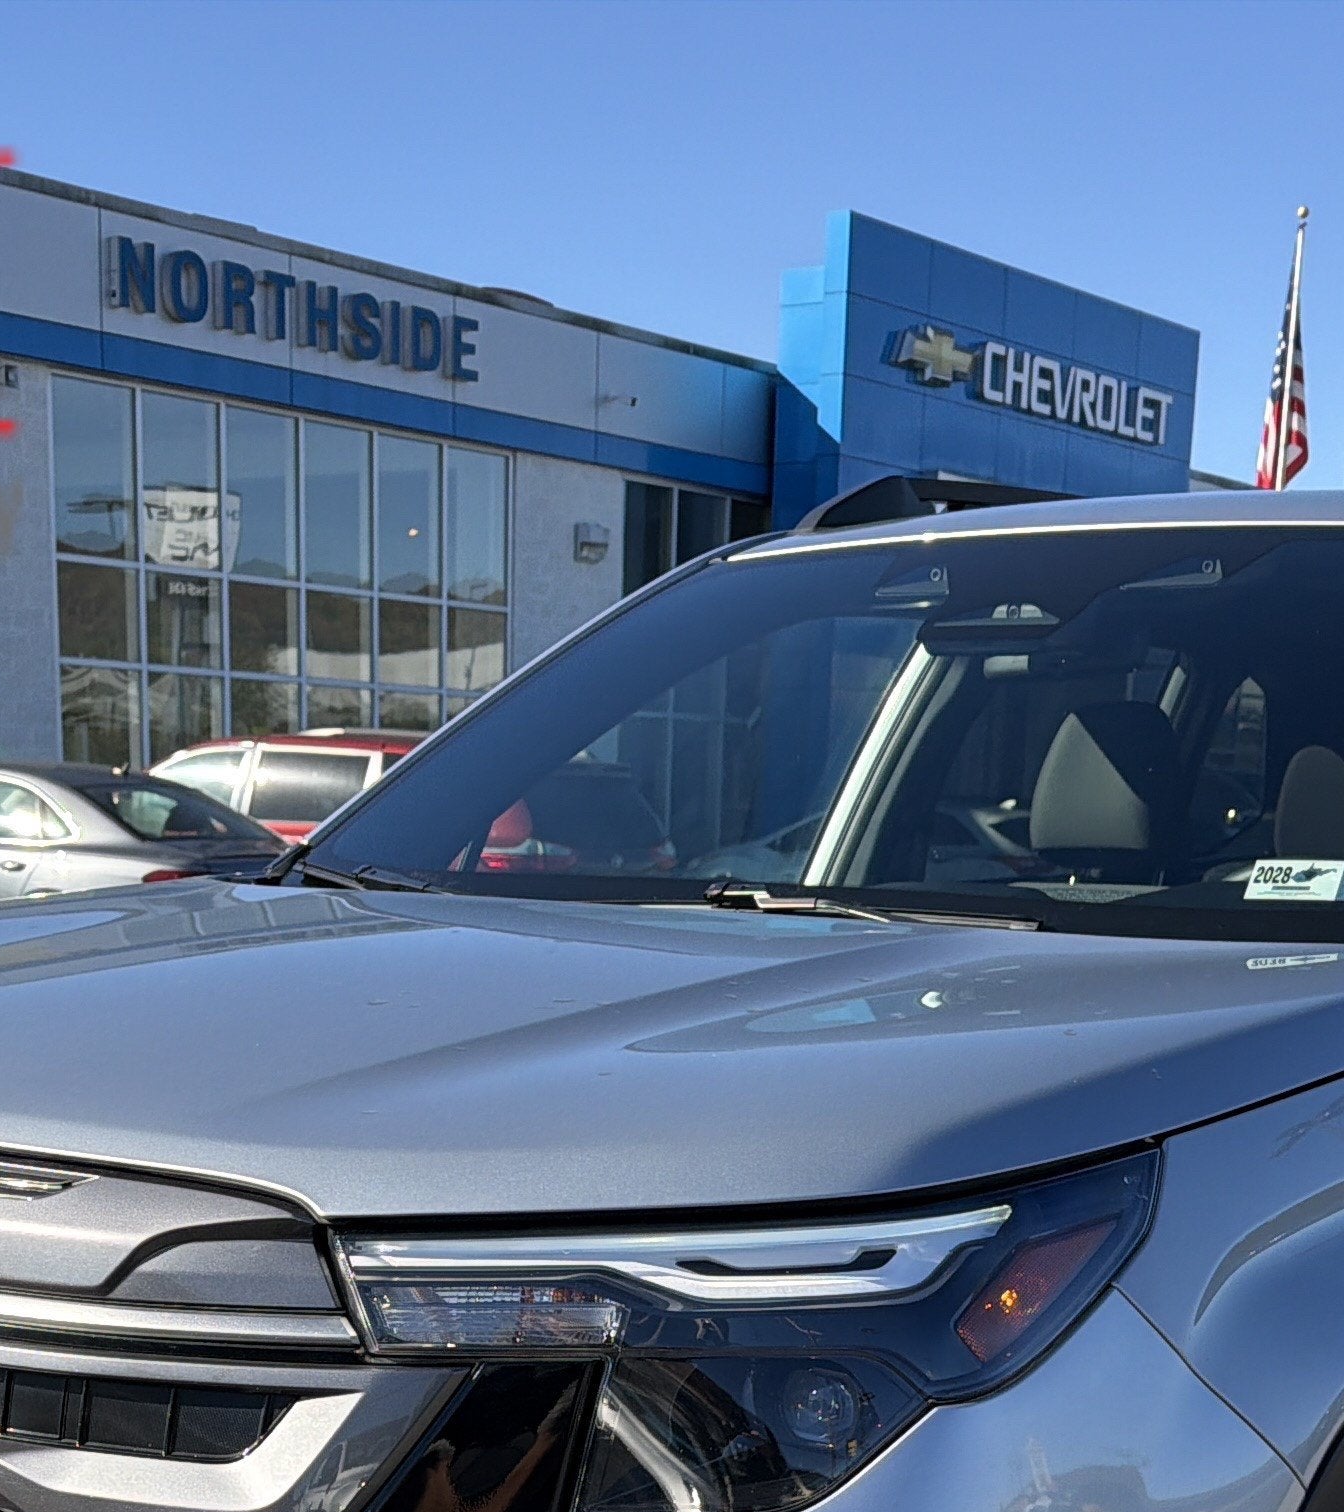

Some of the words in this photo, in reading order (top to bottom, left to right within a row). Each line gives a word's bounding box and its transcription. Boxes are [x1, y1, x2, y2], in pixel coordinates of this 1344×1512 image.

[106, 234, 480, 384] NORTHSIDE
[980, 340, 1174, 447] CHEVROLET
[1253, 866, 1293, 884] 2028
